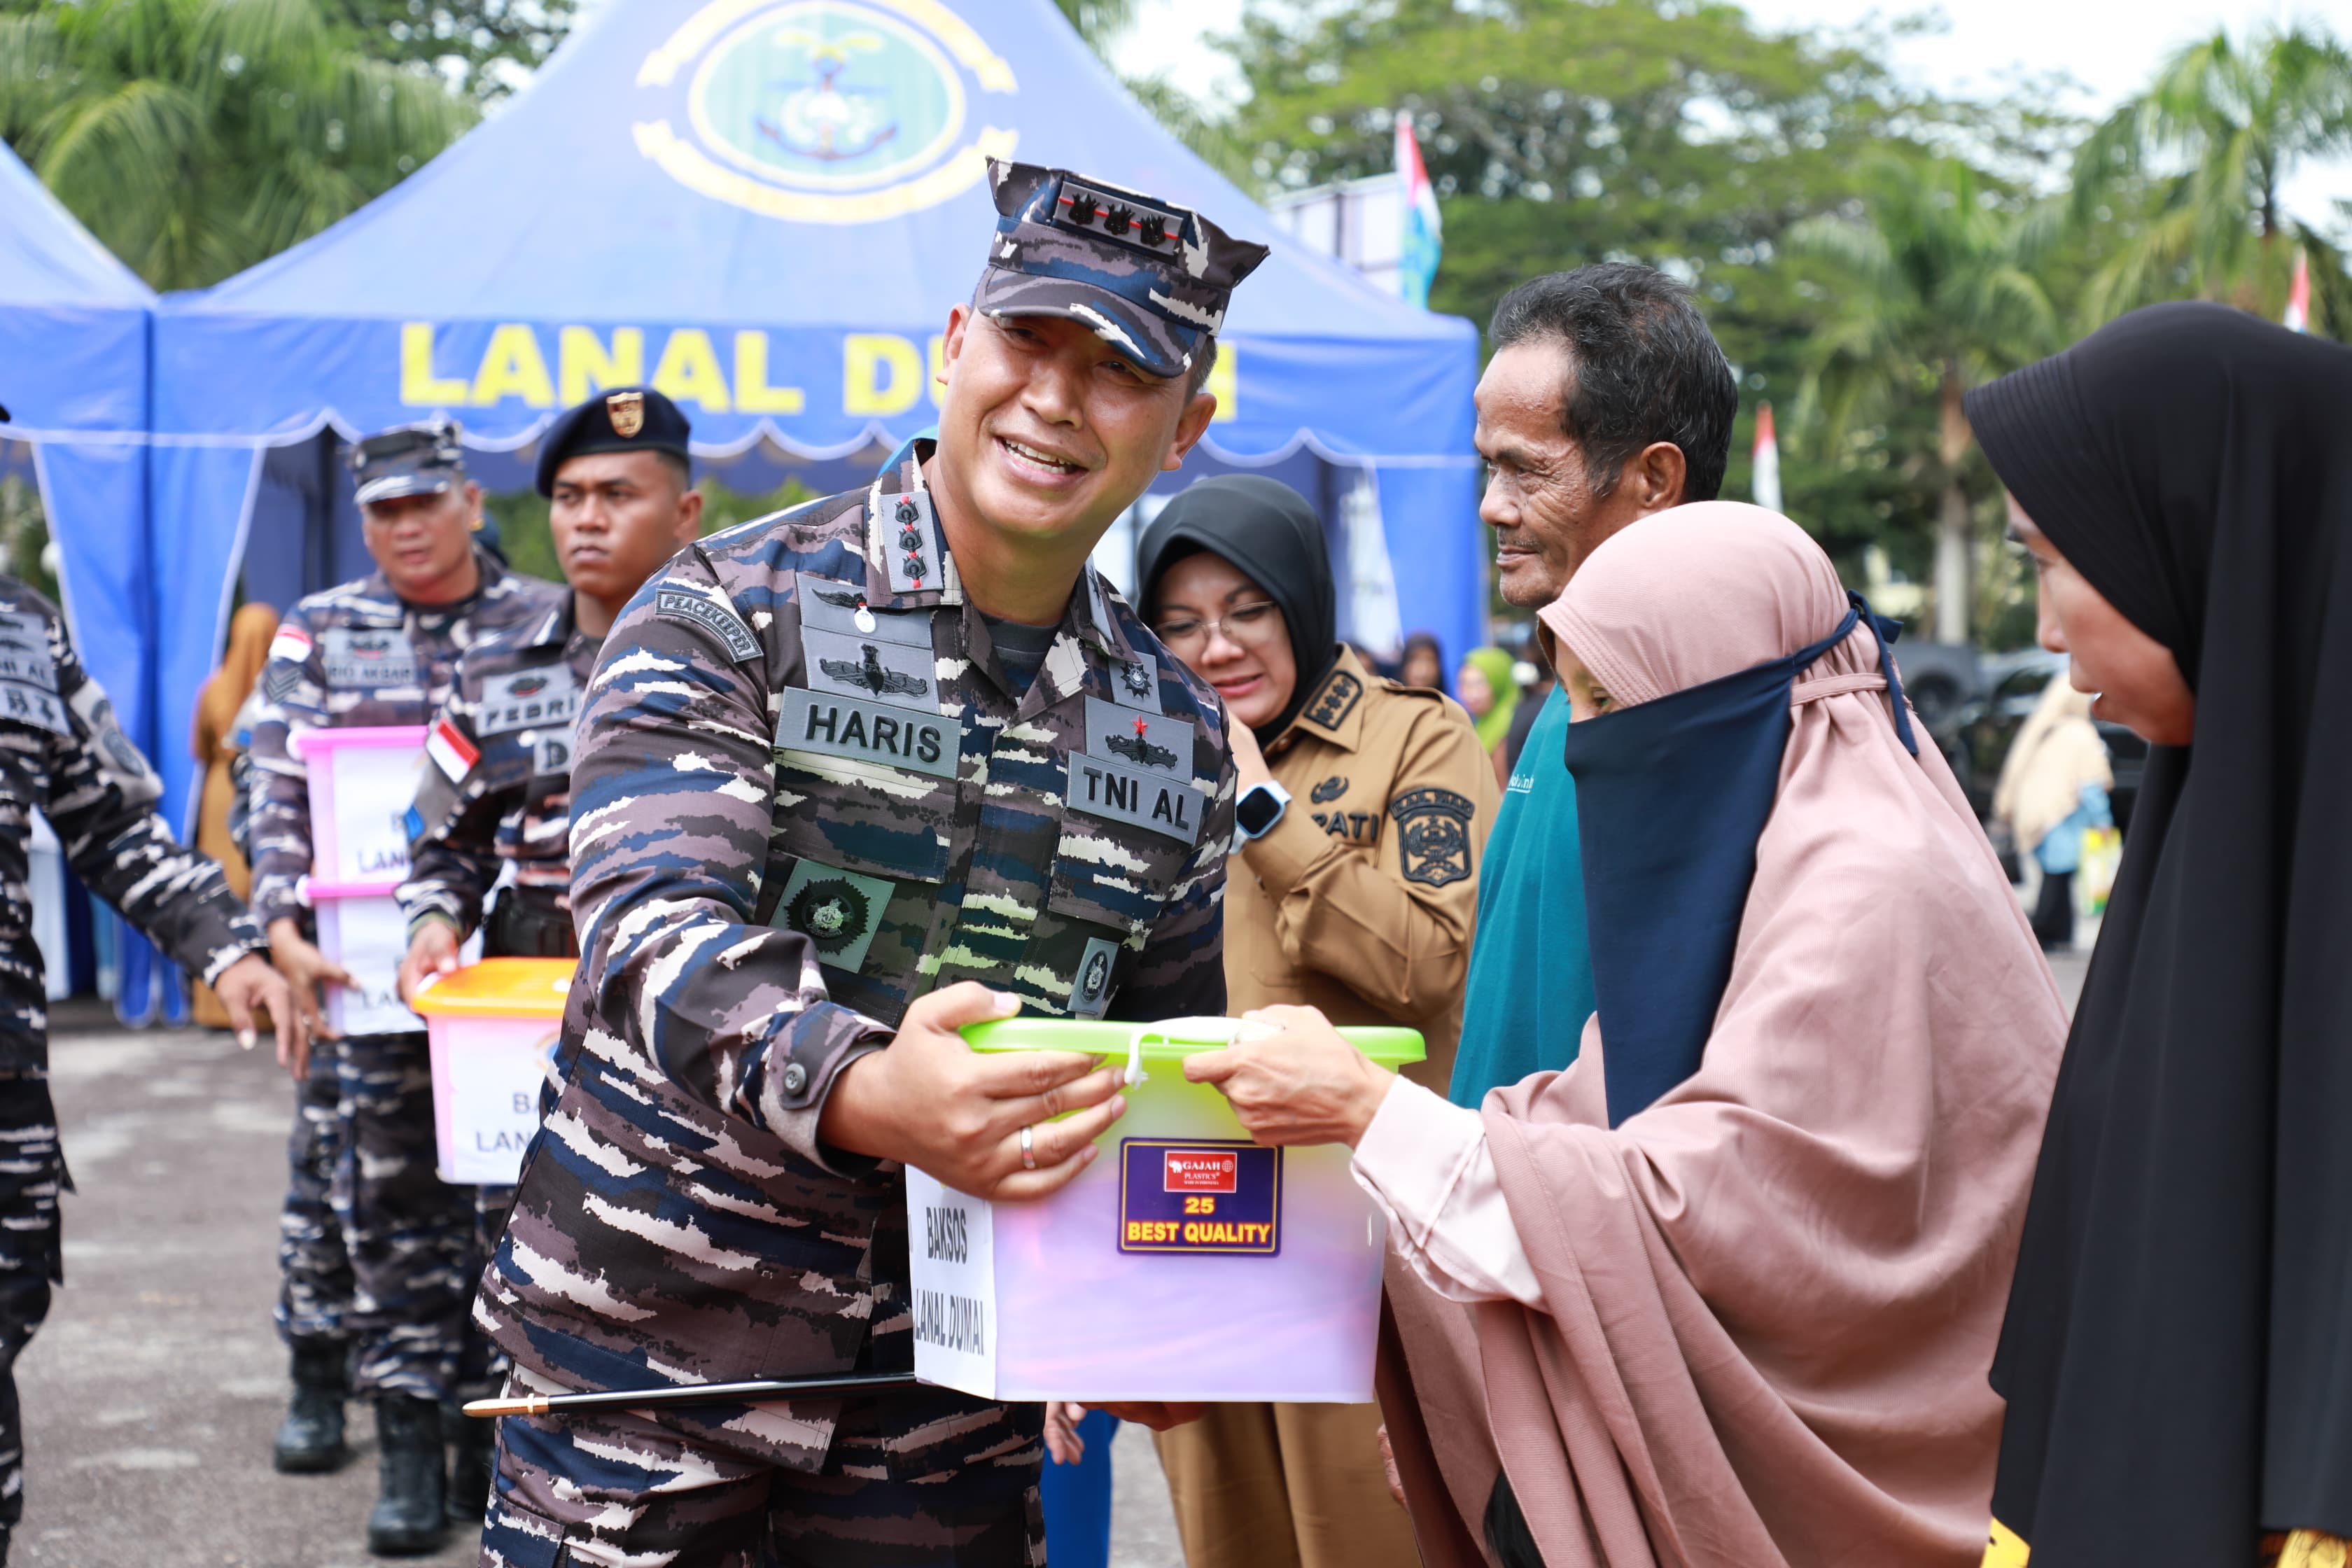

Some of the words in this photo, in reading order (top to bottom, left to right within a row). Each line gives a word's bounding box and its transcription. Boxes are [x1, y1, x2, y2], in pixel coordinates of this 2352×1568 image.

[400, 321, 805, 415] LANAL
[663, 596, 752, 653] PEACEKEEPER
[806, 704, 941, 763] HARIS
[1083, 765, 1138, 813] TNI
[1152, 788, 1189, 831] AL
[357, 850, 405, 873] LAN
[475, 1130, 532, 1152] LAN
[1183, 1161, 1220, 1170] GAJAH
[1127, 1222, 1180, 1242] BEST
[1184, 1223, 1271, 1244] QUALITY
[1184, 1197, 1215, 1214] 25
[926, 1206, 967, 1264] BAKSOS
[915, 1289, 946, 1347] LANAL
[948, 1294, 984, 1357] DUMAI
